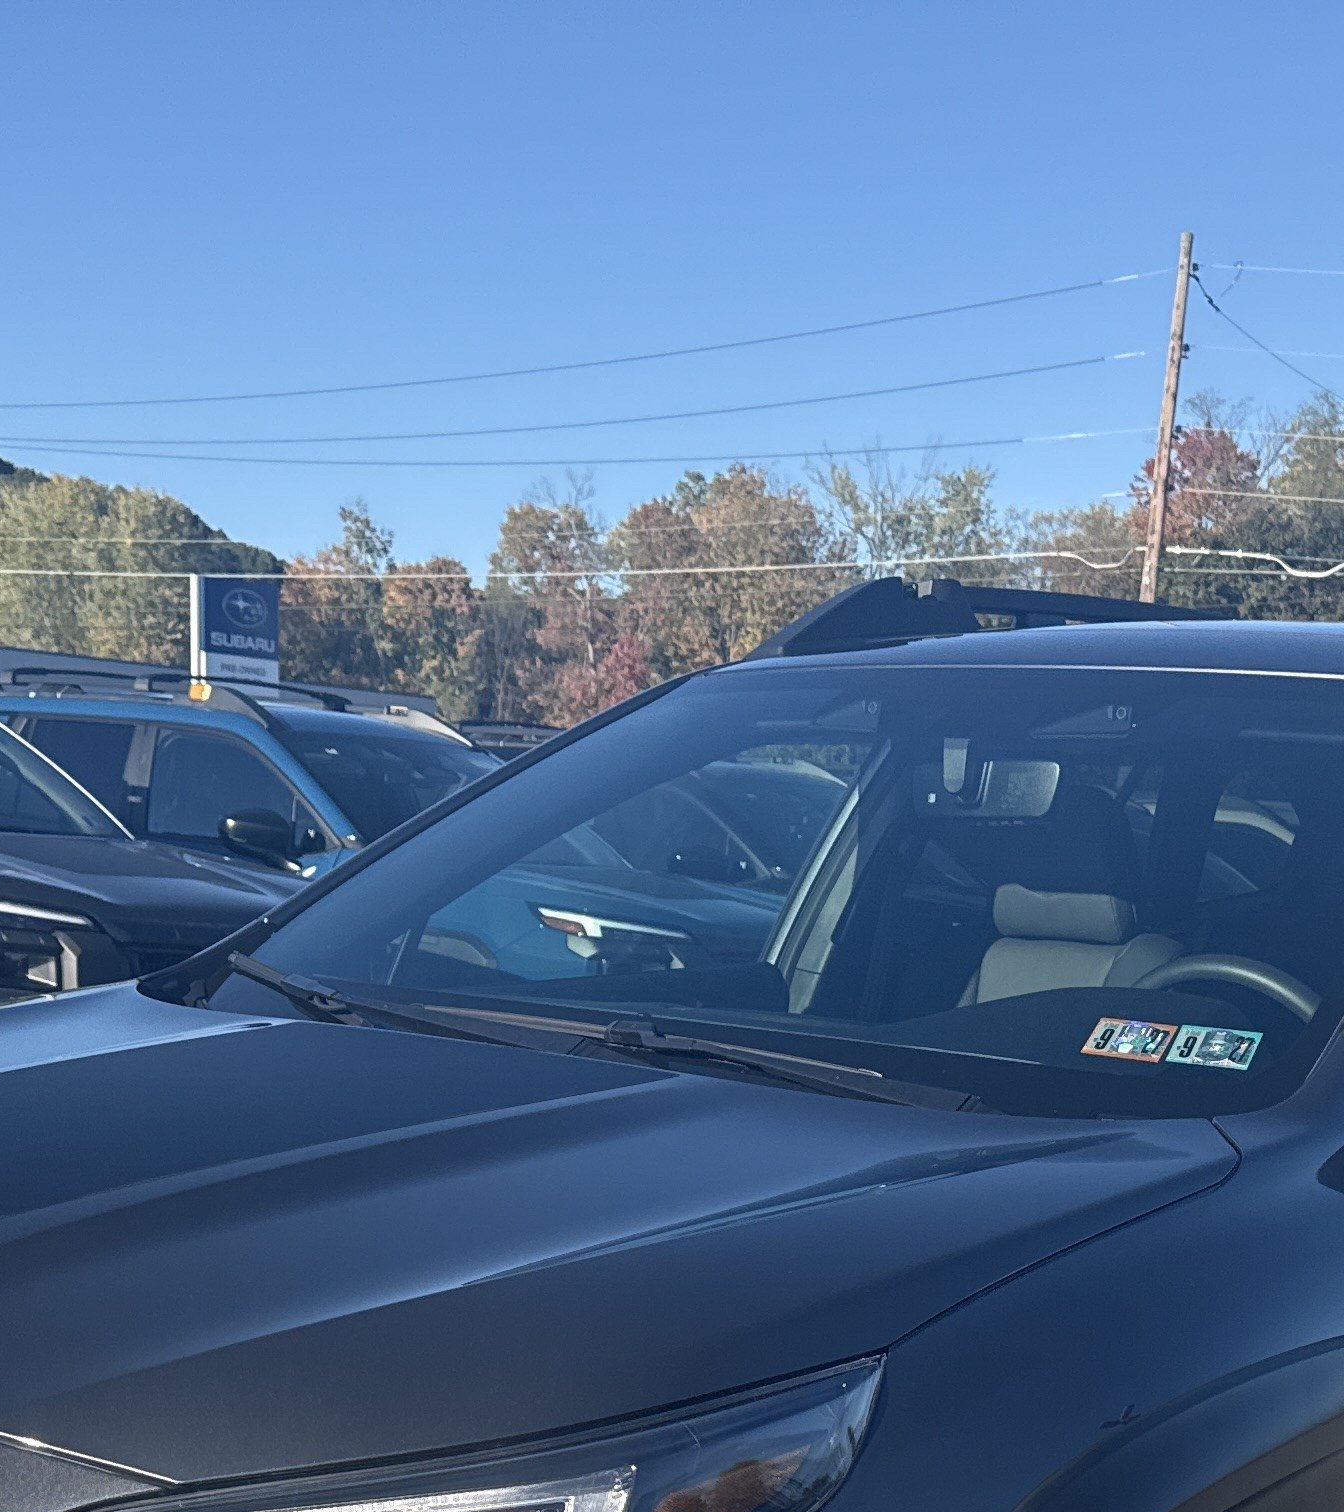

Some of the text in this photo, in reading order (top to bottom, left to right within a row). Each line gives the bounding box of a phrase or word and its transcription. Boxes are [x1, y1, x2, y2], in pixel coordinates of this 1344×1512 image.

[210, 631, 275, 653] SUBARU
[1094, 1028, 1115, 1050] 9
[1179, 1036, 1256, 1063] 9 27
